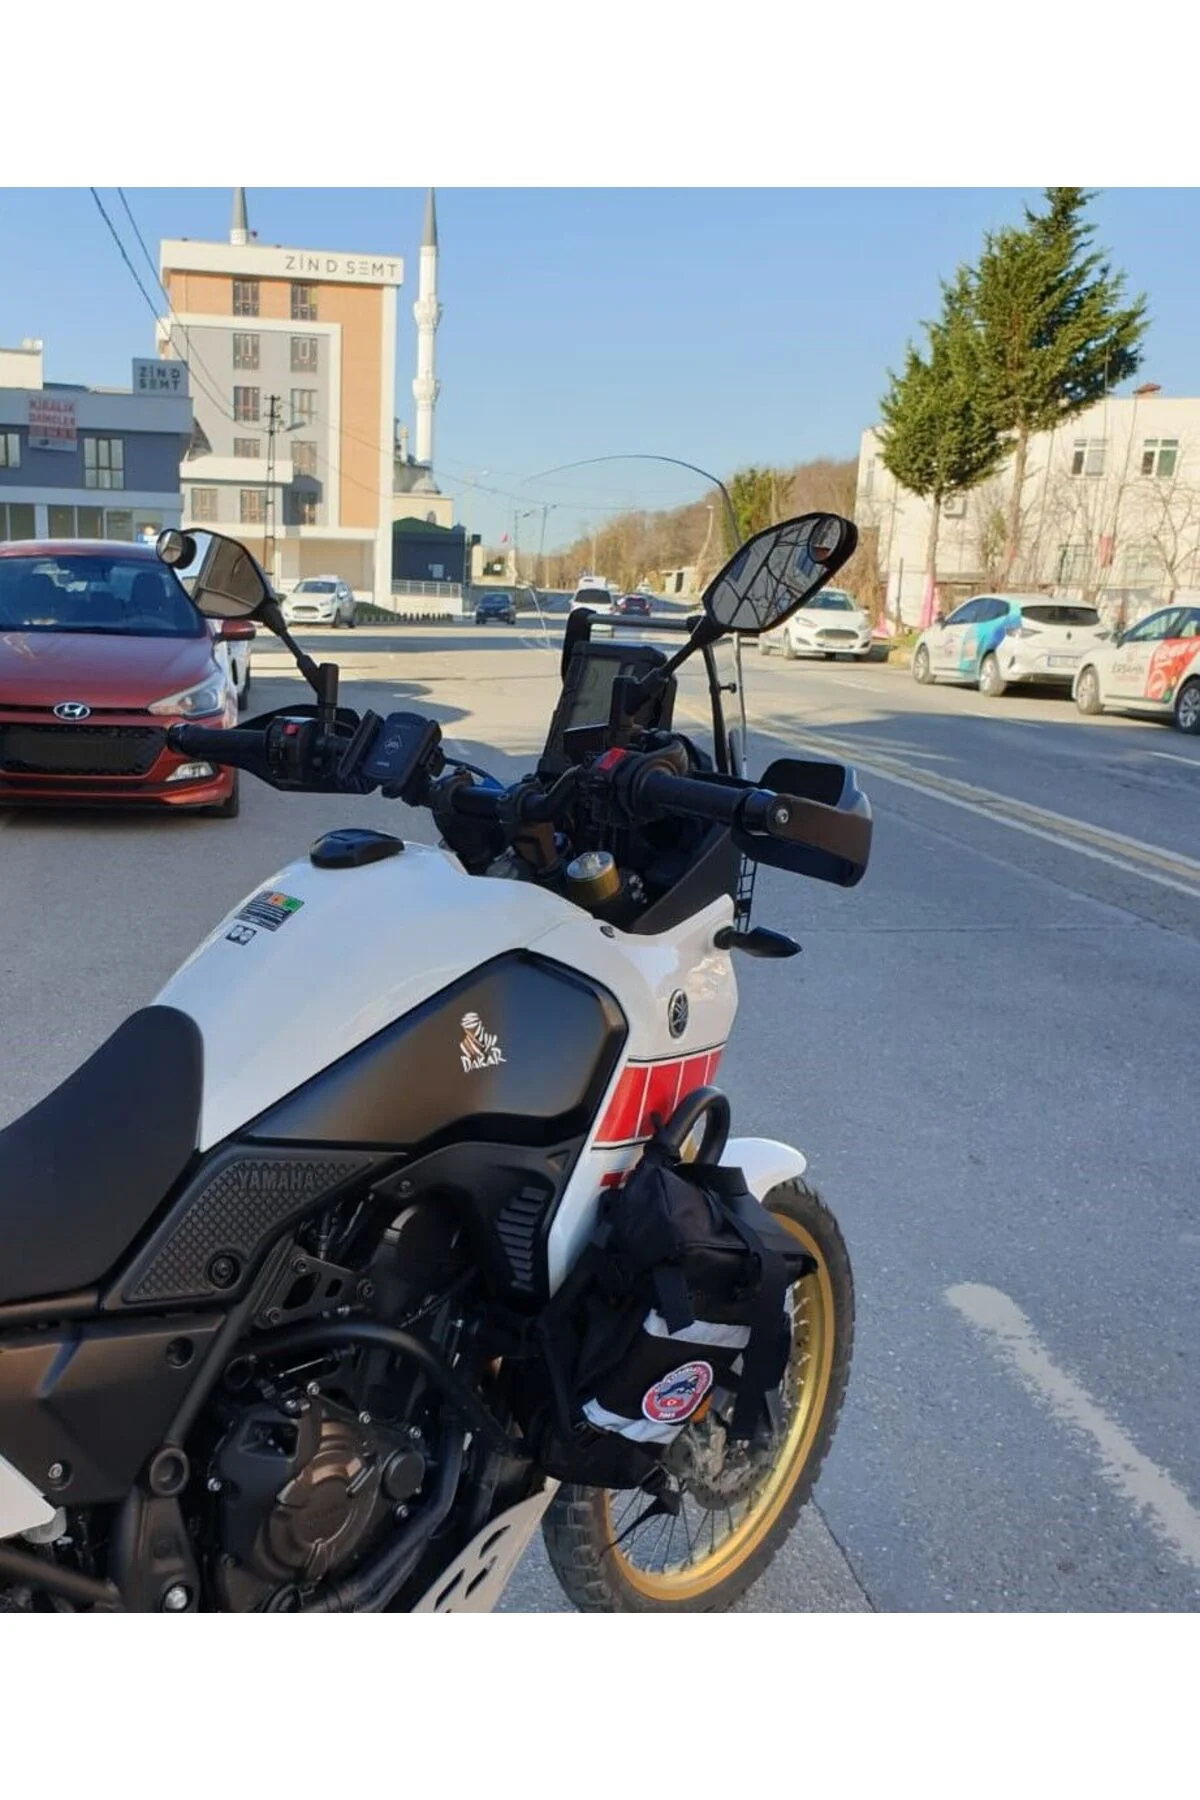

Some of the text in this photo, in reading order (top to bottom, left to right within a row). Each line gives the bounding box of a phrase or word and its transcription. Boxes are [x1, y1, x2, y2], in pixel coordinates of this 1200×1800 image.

[346, 260, 398, 277] SEMT
[139, 379, 181, 391] SEMT
[460, 1047, 507, 1073] DAKAR
[238, 1169, 315, 1192] YAMAHA
